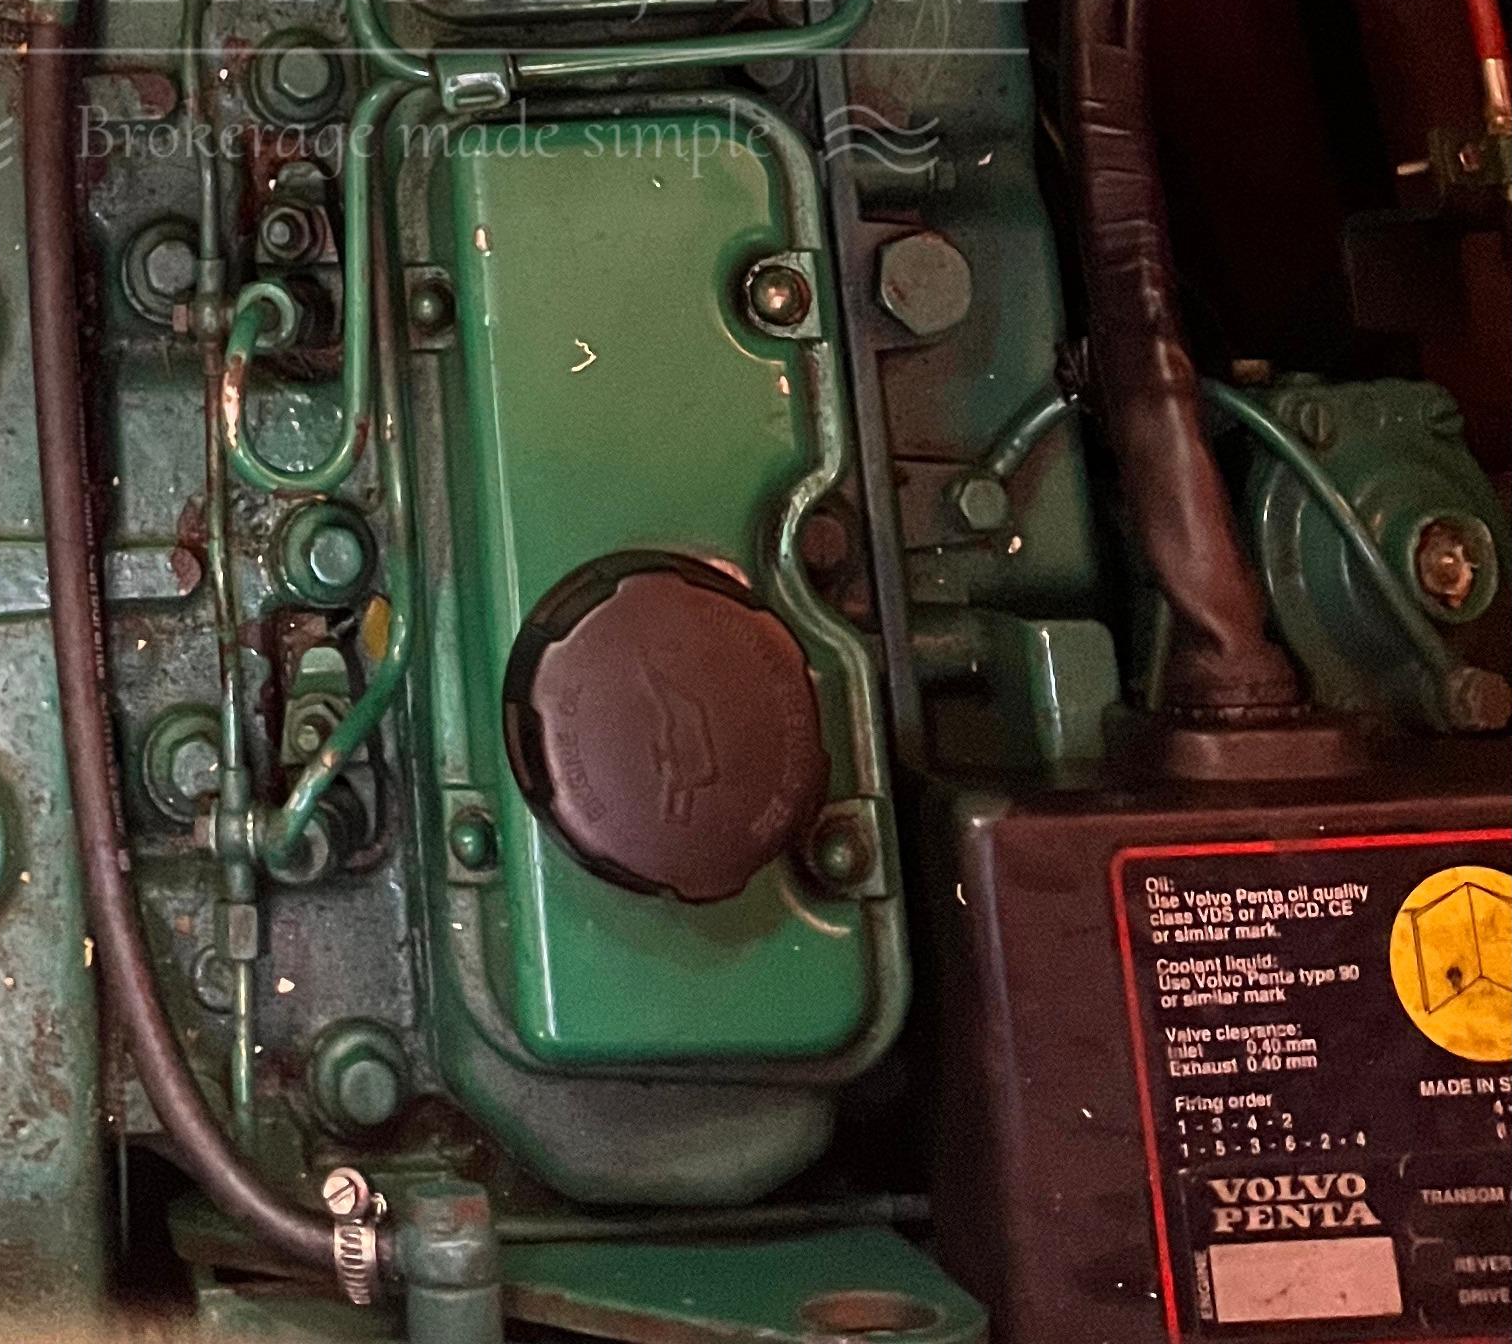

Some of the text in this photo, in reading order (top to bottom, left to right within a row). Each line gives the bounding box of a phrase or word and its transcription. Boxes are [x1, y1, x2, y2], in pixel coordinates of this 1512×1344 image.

[1148, 883, 1368, 909] Use Volvo Penta oil quality
[1150, 910, 1193, 926] class
[1197, 907, 1234, 923] VDS
[1239, 908, 1255, 921] or
[1329, 899, 1354, 916] CE
[1152, 930, 1169, 944] or
[1175, 925, 1230, 942] similar
[1156, 958, 1221, 976] Coolant
[1158, 975, 1191, 991] Use
[1194, 972, 1243, 989] Volvo
[1247, 970, 1295, 986] Penta
[1299, 968, 1335, 986] type
[1161, 987, 1287, 1008] or similar mark
[1165, 1023, 1302, 1043] Valve clearance:
[1167, 1043, 1204, 1059] Inlet
[1170, 1058, 1238, 1077] Exhaust
[1285, 1055, 1318, 1069] mm
[1420, 1078, 1473, 1097] MADE
[1476, 1077, 1495, 1093] IN
[1175, 1093, 1272, 1114] Firing order
[1208, 1173, 1366, 1203] VOLVO
[1420, 1187, 1504, 1203] TRANSOM
[1213, 1201, 1381, 1232] PENTA
